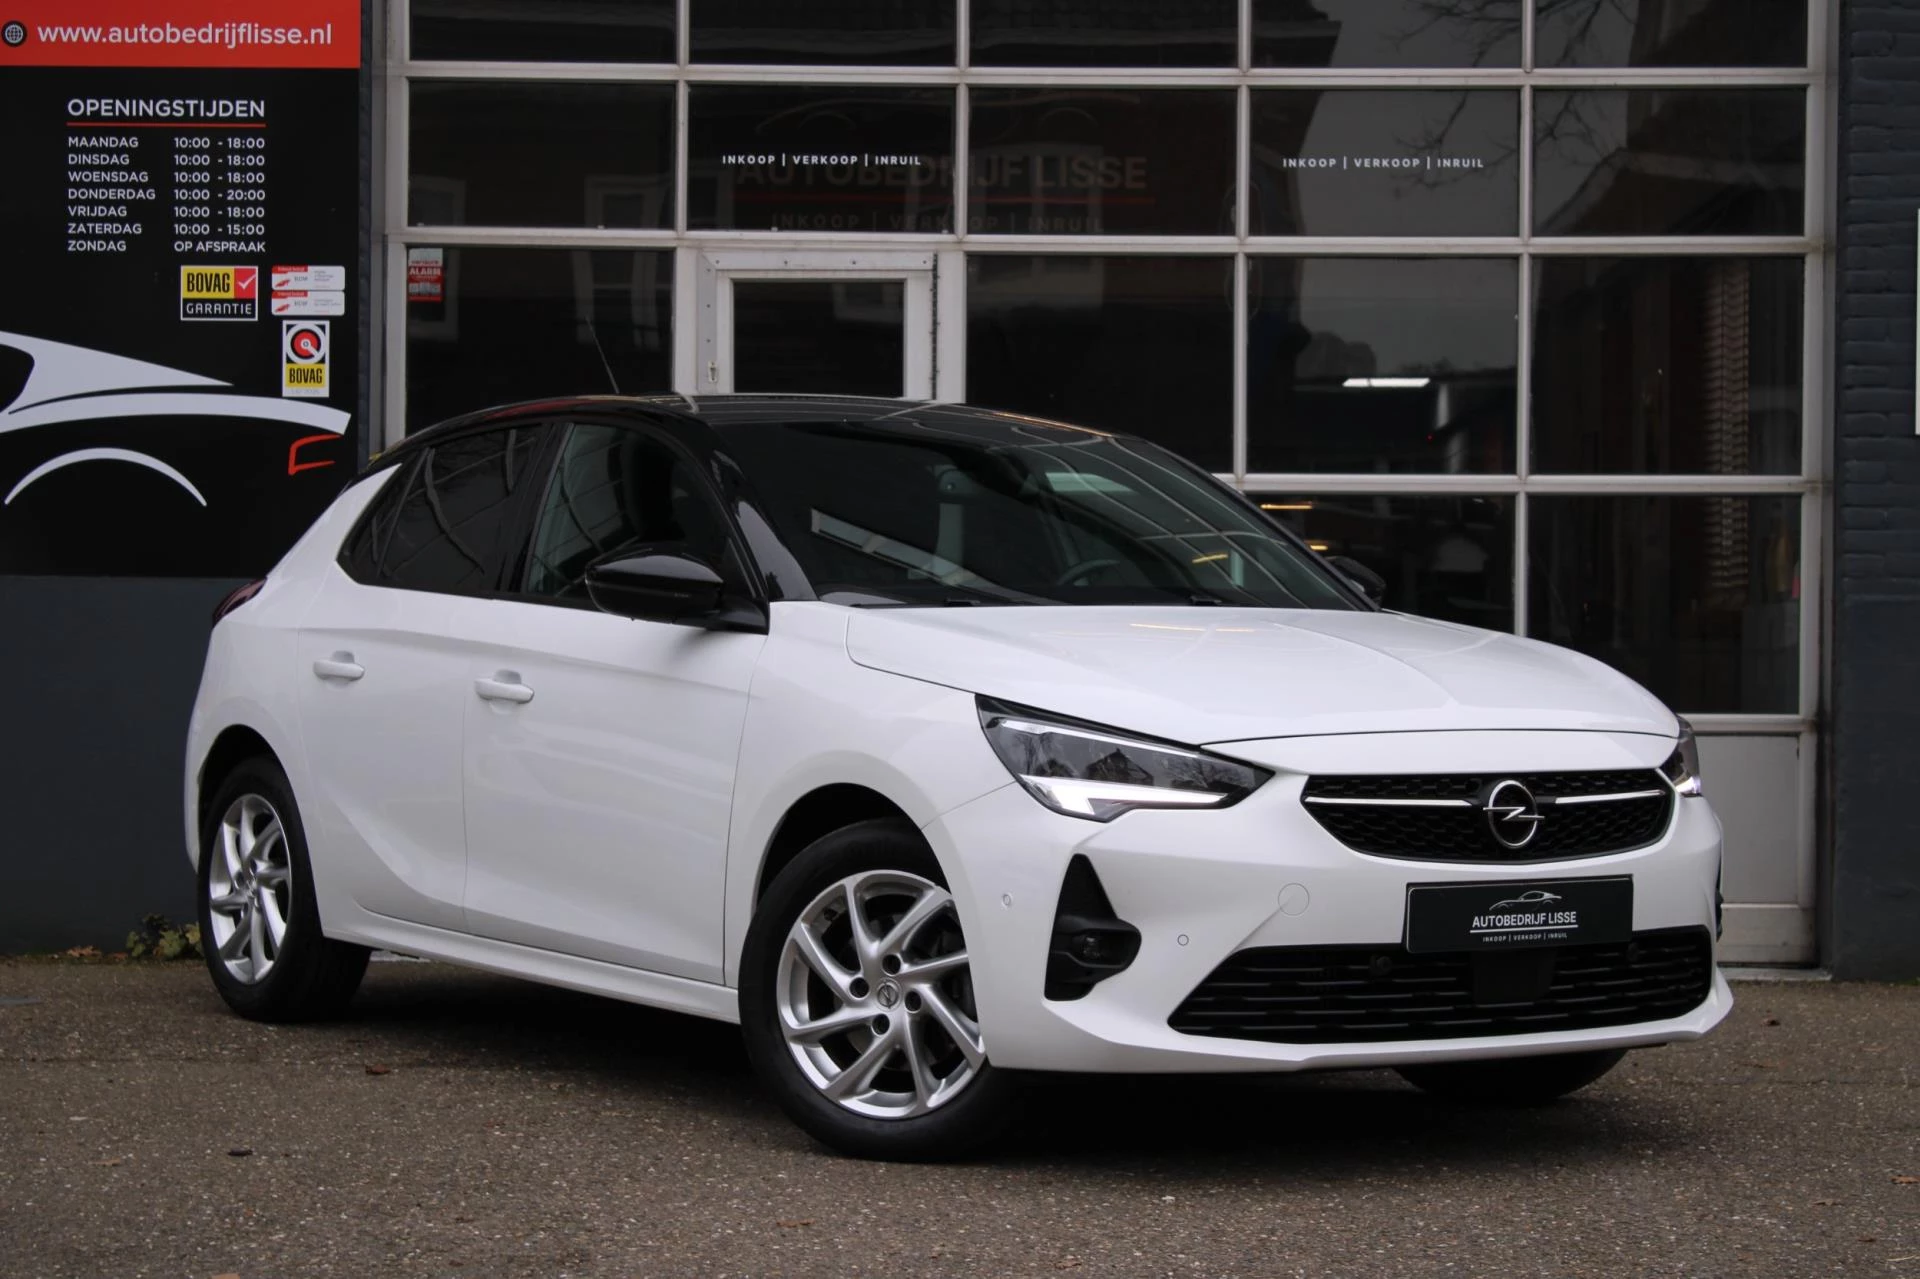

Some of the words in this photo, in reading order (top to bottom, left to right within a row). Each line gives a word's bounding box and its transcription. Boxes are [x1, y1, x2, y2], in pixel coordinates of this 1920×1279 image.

[37, 22, 332, 49] www.autobedrijflisse.nl
[67, 98, 265, 118] OPENINGSTIJDEN
[68, 136, 139, 148] MAANDAG
[173, 137, 211, 149] 10:00
[226, 137, 266, 149] 18:00
[68, 153, 130, 165] DINSDAG
[173, 154, 211, 166] 10:00
[226, 154, 266, 166] 18:00
[722, 154, 776, 165] INKOOP
[792, 155, 858, 165] VERKOOP
[874, 155, 921, 166] INRUIL
[1283, 157, 1337, 168] INKOOP
[1353, 157, 1420, 168] VERKOOP
[1437, 157, 1484, 168] INRUIL
[67, 171, 149, 183] WOENSDAG
[173, 171, 211, 183] 10:00
[226, 171, 266, 183] 18:00
[1035, 156, 1148, 189] LISSE
[68, 188, 156, 200] DONDERDAG
[173, 189, 211, 201] 10:00
[226, 189, 266, 201] 20:00
[67, 205, 128, 217] VRIJDAG
[173, 206, 211, 218] 10:00
[226, 206, 266, 218] 18:00
[67, 222, 142, 234] ZATERDAG
[173, 223, 211, 235] 10:00
[226, 223, 266, 235] 15:00
[889, 214, 998, 232] VERKOP
[67, 239, 127, 252] ZONDAG
[173, 240, 193, 252] OP
[195, 241, 266, 253] AFSPRAAK
[409, 266, 442, 276] ALARM
[186, 272, 231, 293] BOVAG
[186, 302, 253, 315] GARANTIE
[289, 367, 323, 384] BOVAG
[1472, 912, 1547, 928] AUTOBEDRIJF
[1548, 911, 1577, 924] LISSE
[1482, 935, 1507, 943] INKOOP
